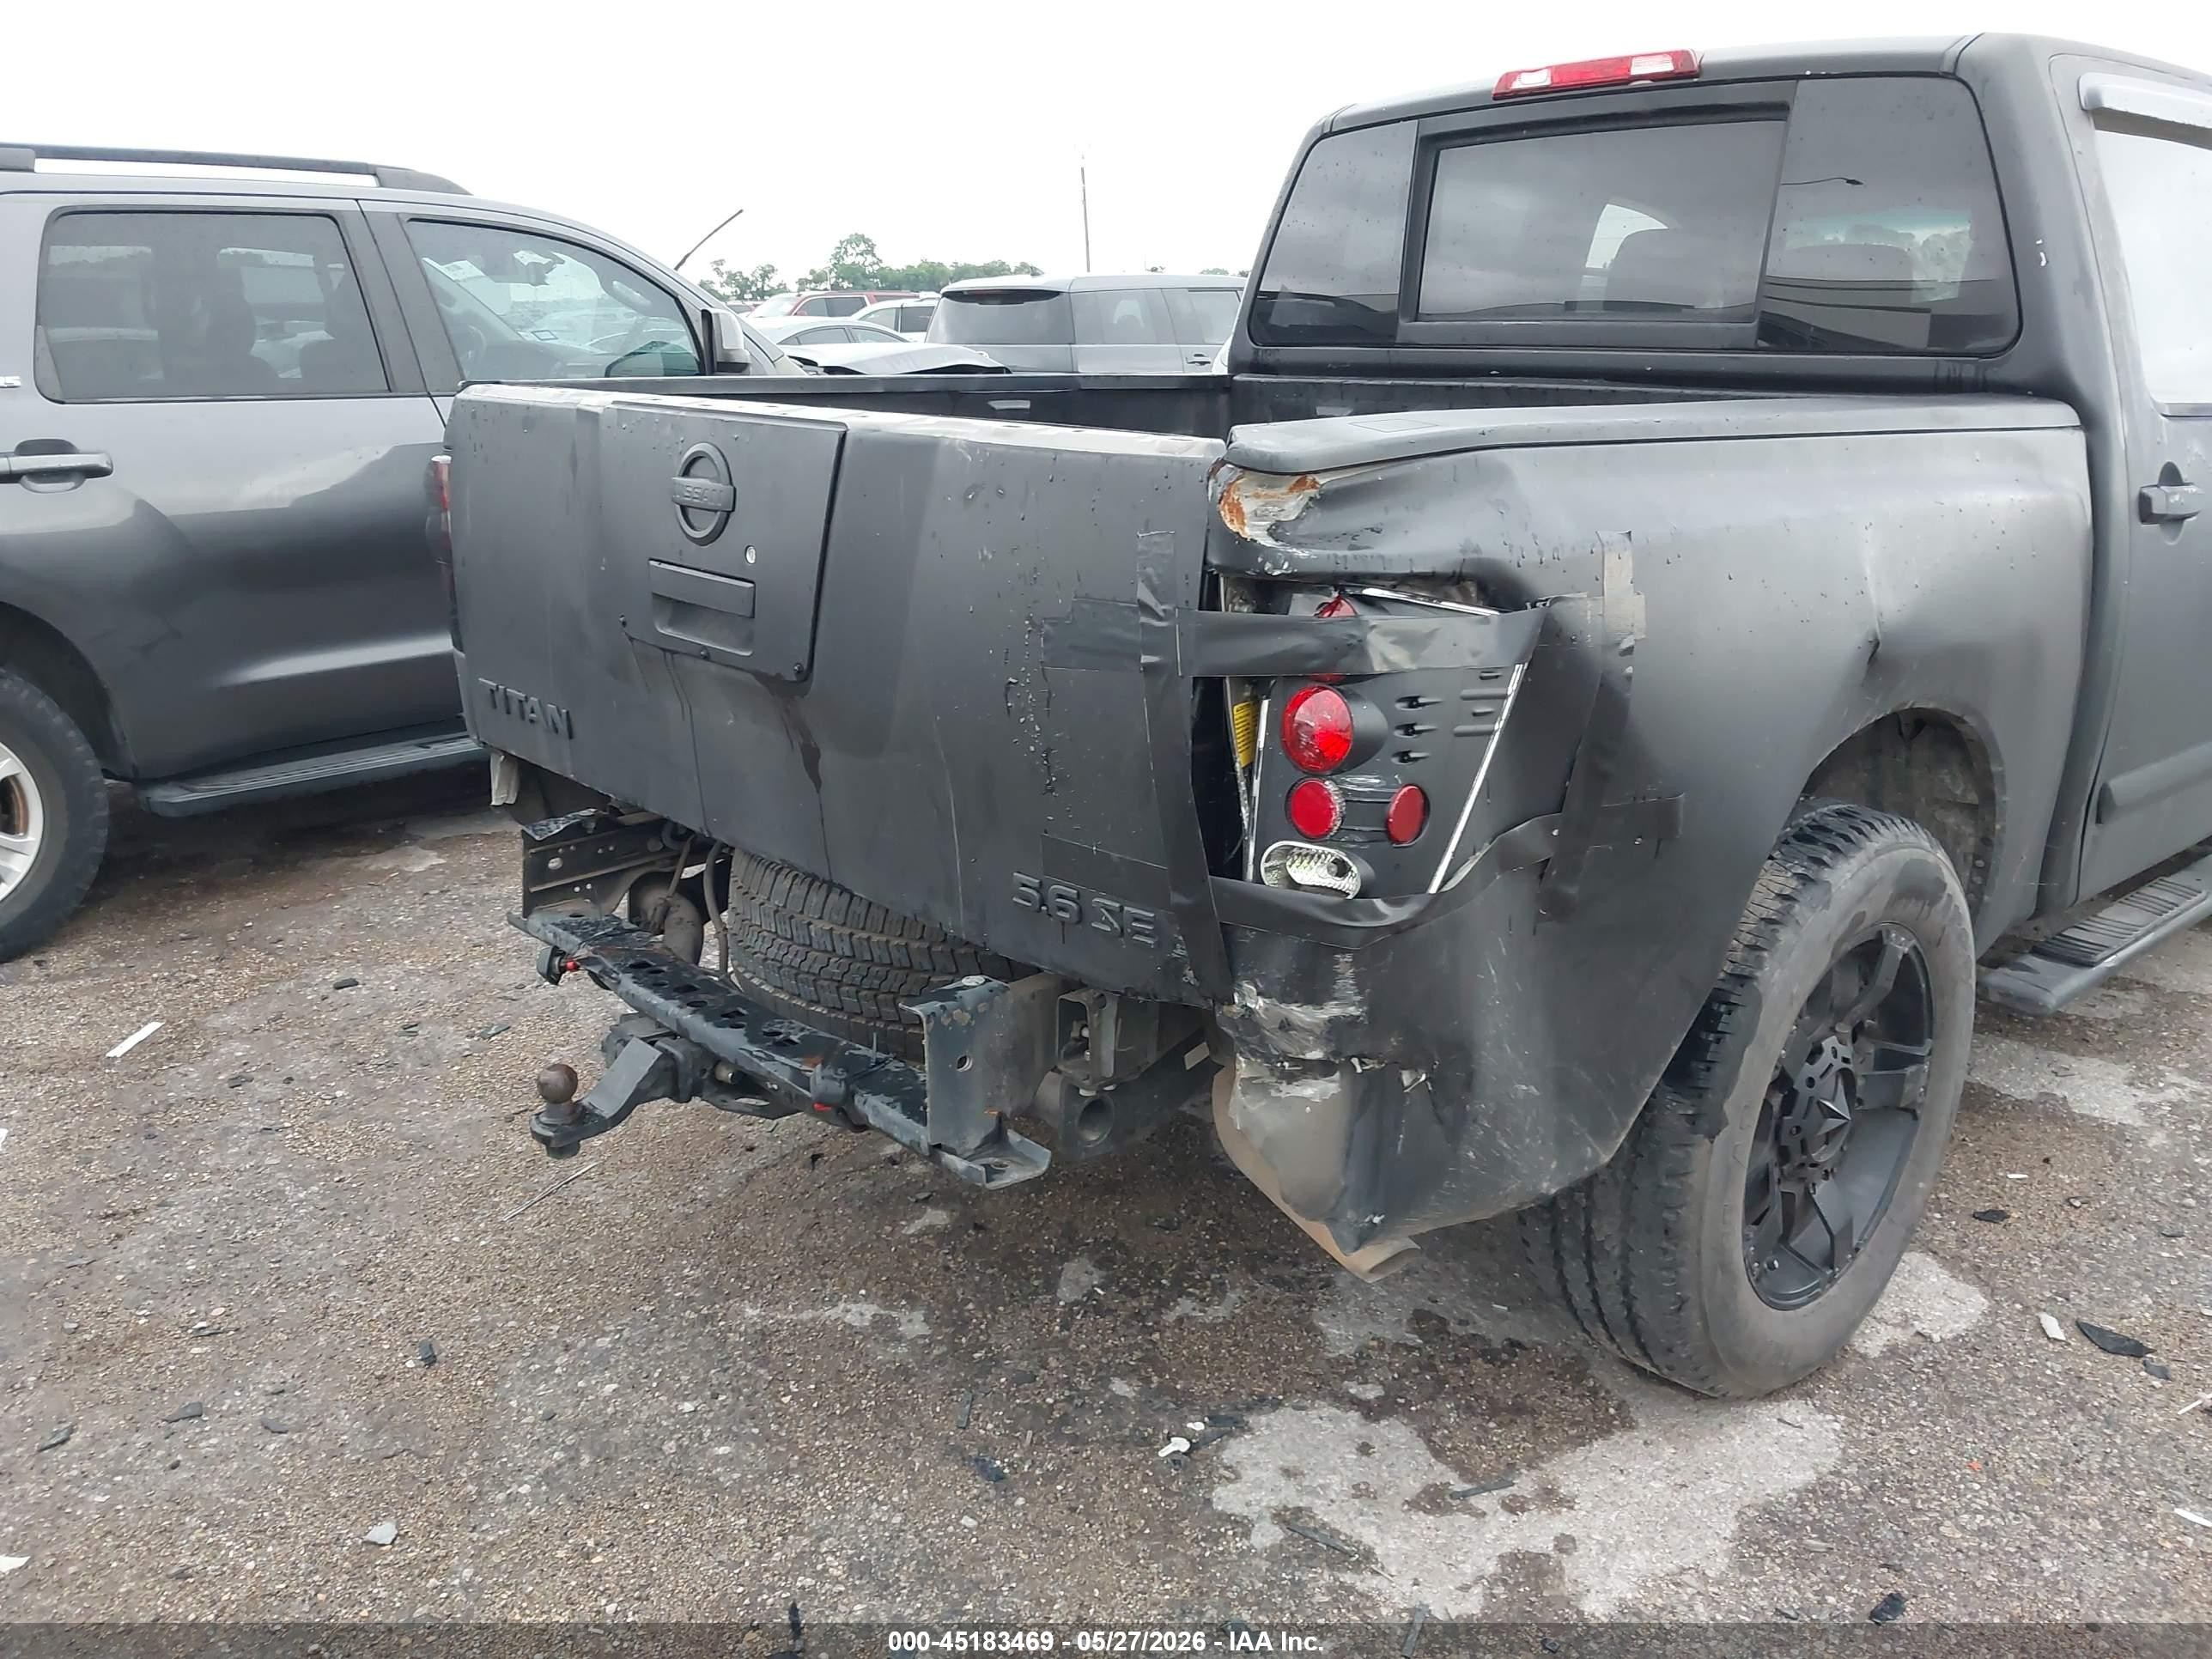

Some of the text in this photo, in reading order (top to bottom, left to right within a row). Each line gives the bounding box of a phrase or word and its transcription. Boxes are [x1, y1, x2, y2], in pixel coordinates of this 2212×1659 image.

[477, 677, 574, 740] TITAN
[1012, 871, 1158, 948] 5.6 SE
